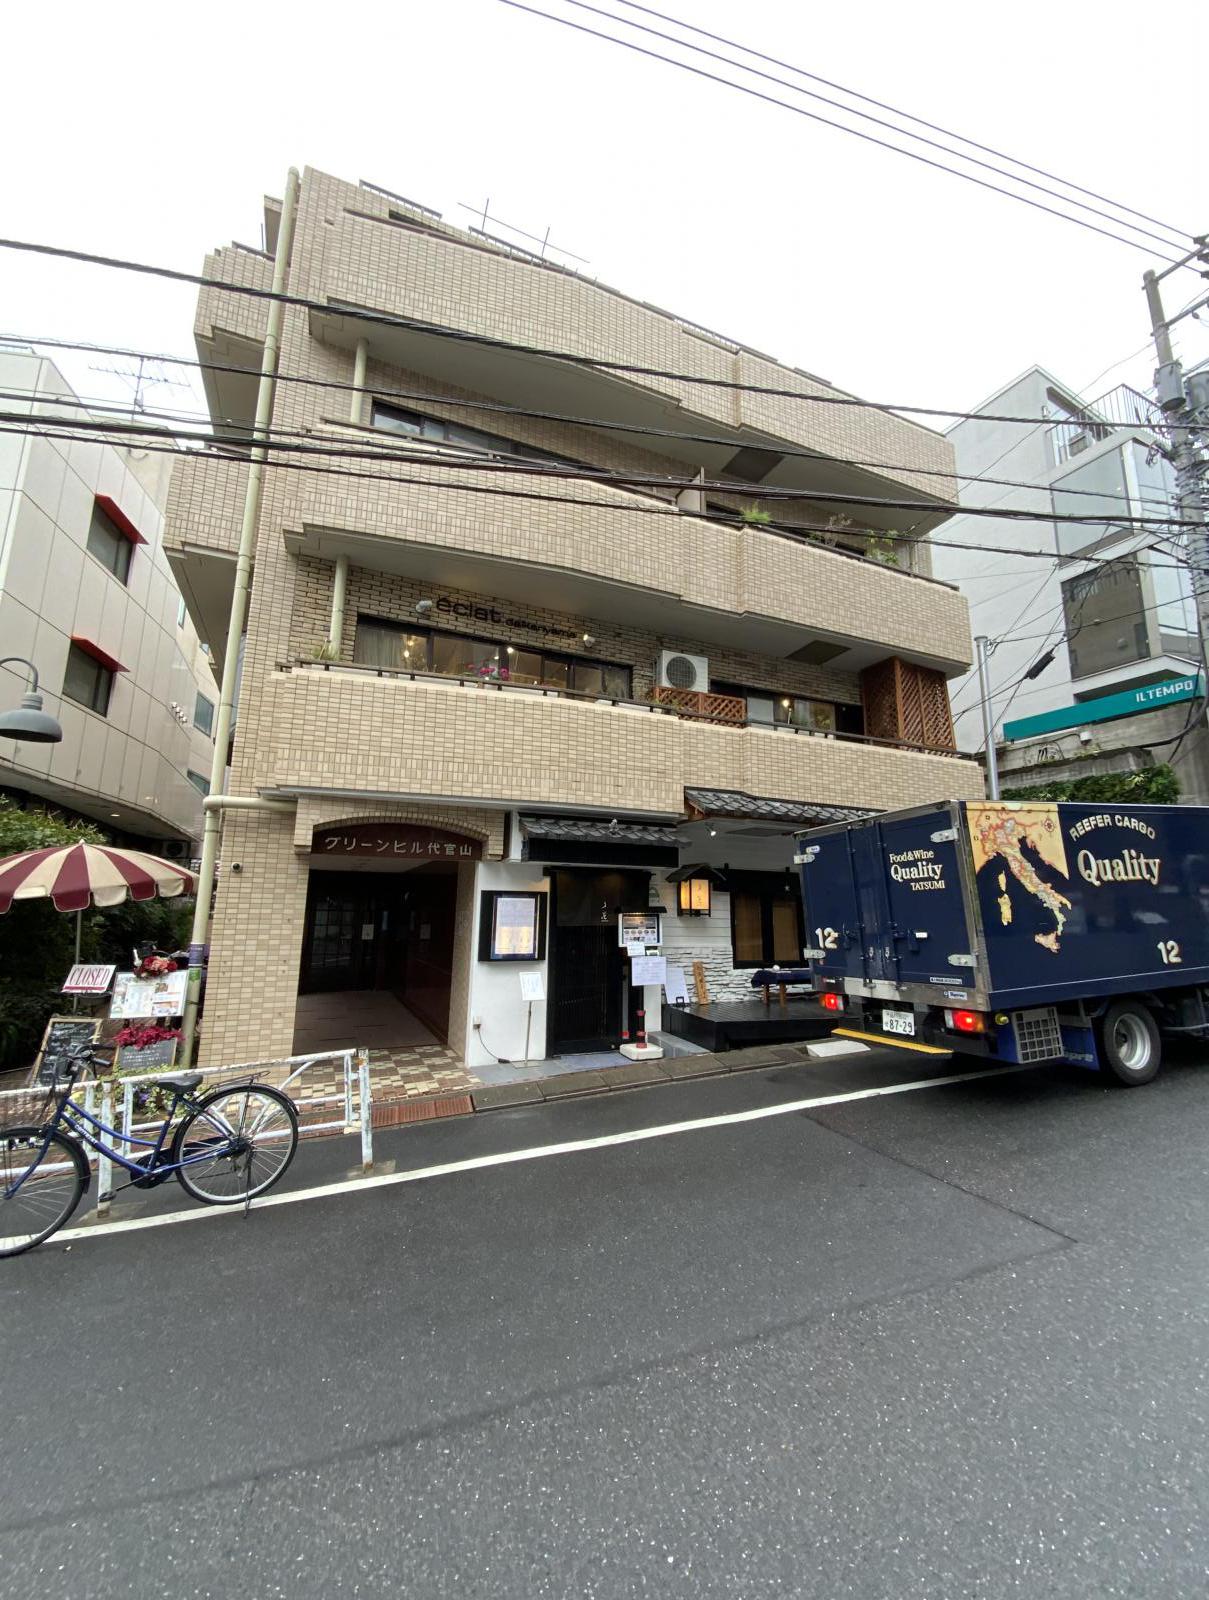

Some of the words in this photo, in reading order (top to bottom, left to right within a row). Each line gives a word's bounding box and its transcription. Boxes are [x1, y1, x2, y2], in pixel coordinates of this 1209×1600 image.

[1147, 680, 1193, 699] TEMPO
[1069, 814, 1112, 841] REEFER
[1114, 814, 1156, 840] CARGO
[890, 860, 943, 882] Quality
[1077, 849, 1161, 887] Quality
[910, 880, 945, 891] TATSUMI
[815, 927, 839, 949] 12
[1157, 940, 1182, 964] 12
[69, 967, 111, 986] CLOSED
